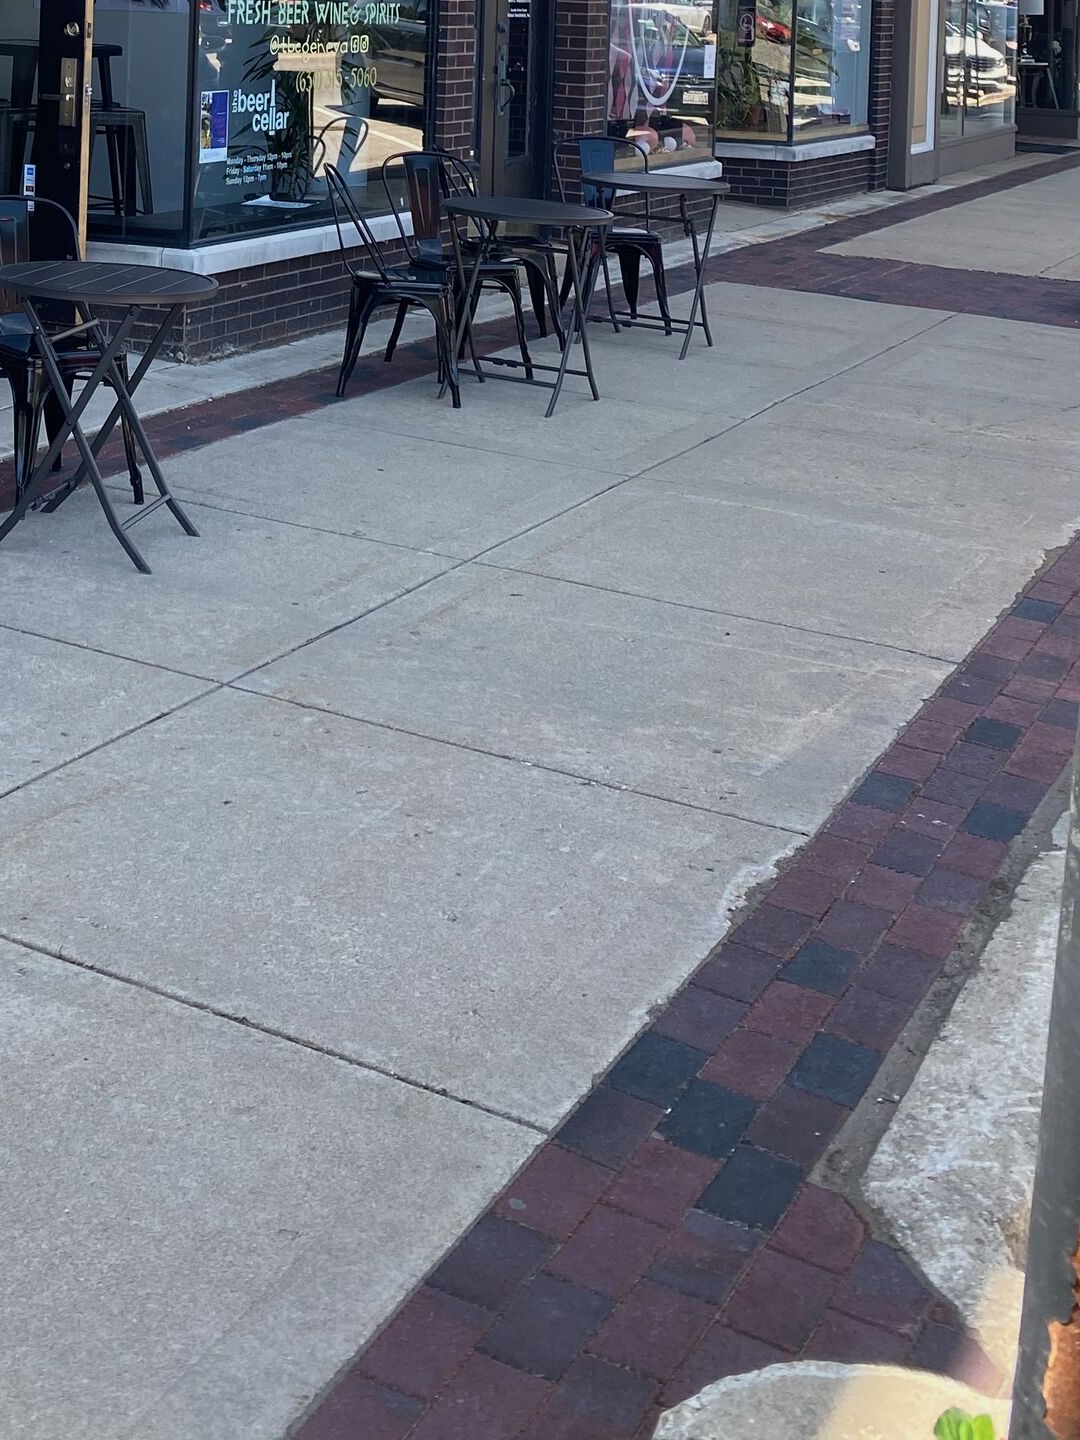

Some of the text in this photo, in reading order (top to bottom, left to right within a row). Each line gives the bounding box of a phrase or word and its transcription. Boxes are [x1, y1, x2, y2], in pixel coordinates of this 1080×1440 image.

[227, 0, 270, 25] FRESH
[278, 0, 309, 25] BEER
[364, 2, 400, 25] SPIRITS
[238, 89, 270, 112] beer
[252, 106, 290, 136] cellar
